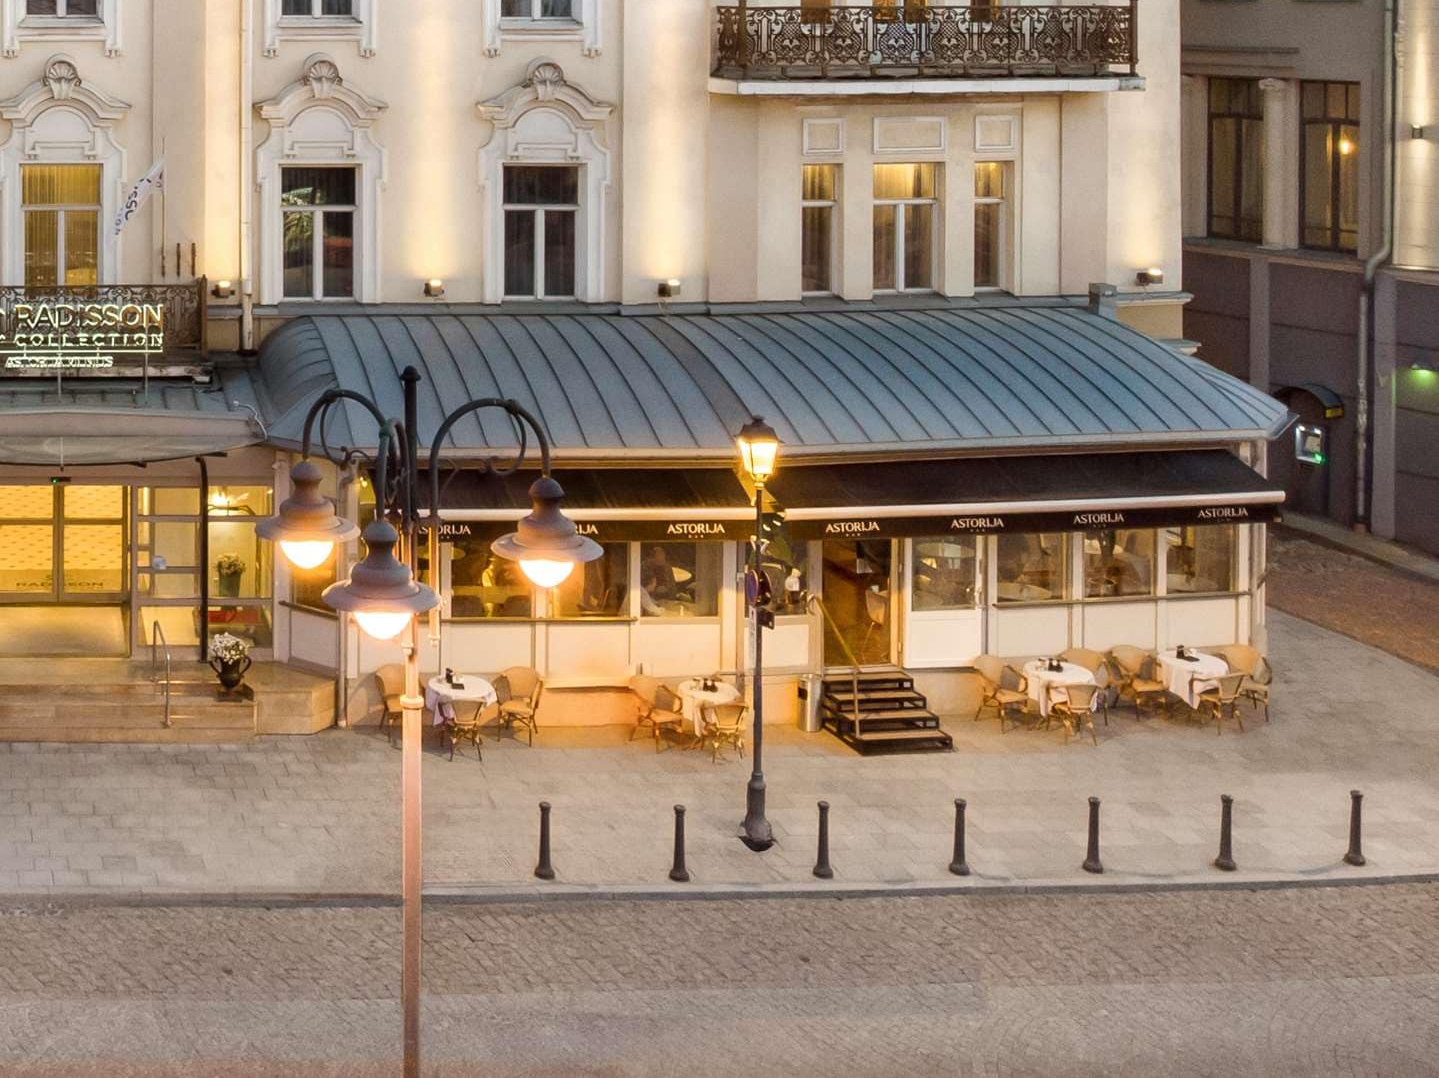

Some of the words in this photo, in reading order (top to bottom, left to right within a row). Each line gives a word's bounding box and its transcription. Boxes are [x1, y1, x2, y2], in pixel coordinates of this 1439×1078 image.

[14, 304, 164, 329] RADISSON
[13, 333, 164, 347] COLLECTION
[1197, 507, 1249, 518] ASTORIJA
[951, 517, 1005, 529] ASTORIJA
[1073, 513, 1125, 525] ASTORIJA
[666, 523, 726, 534] ASTORIJA
[825, 521, 880, 534] ASTORIJA
